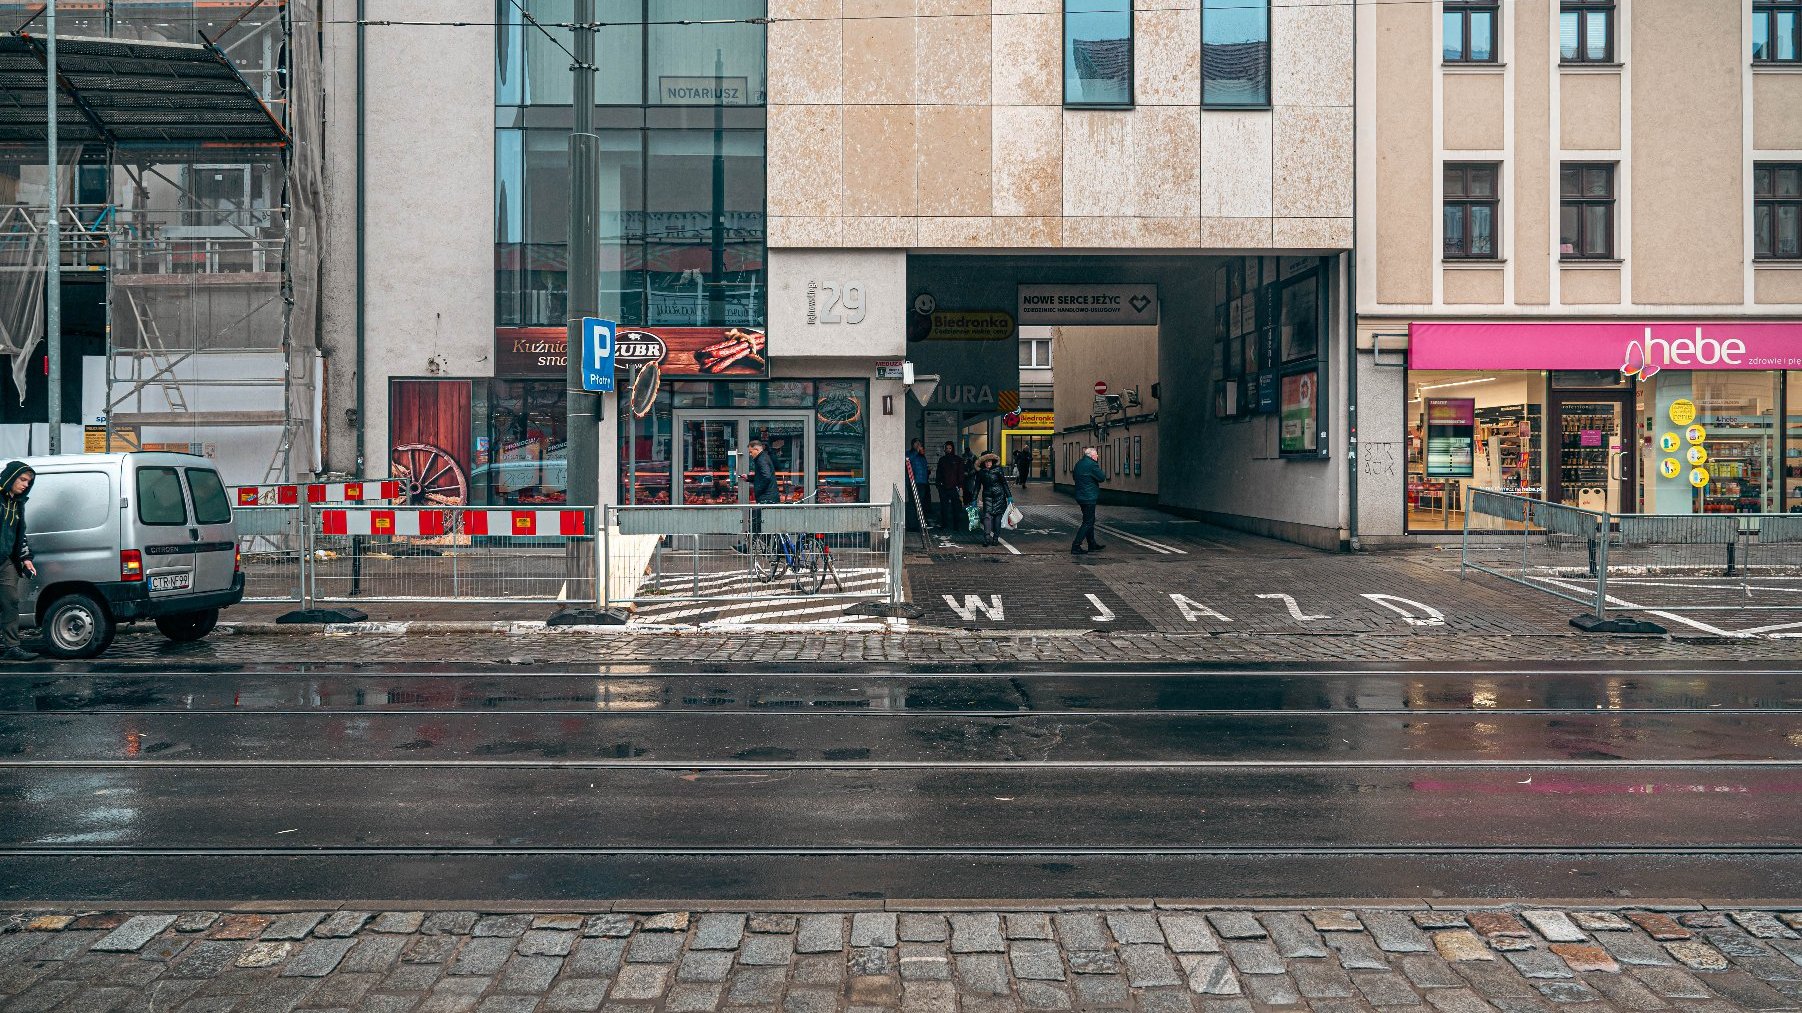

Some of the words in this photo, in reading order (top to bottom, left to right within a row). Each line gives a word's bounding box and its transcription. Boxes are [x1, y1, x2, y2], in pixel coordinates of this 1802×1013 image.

[668, 87, 739, 99] NOTARIUSZ
[820, 280, 867, 325] 29
[1023, 295, 1055, 305] NOWE
[1058, 295, 1089, 305] SERCE
[1090, 293, 1121, 305] JEŻYC
[934, 314, 1009, 328] Biedronka
[593, 325, 611, 370] P
[1644, 326, 1747, 366] hebe
[1748, 356, 1782, 366] zdrowie
[936, 384, 995, 403] IURA
[152, 576, 169, 588] CTR
